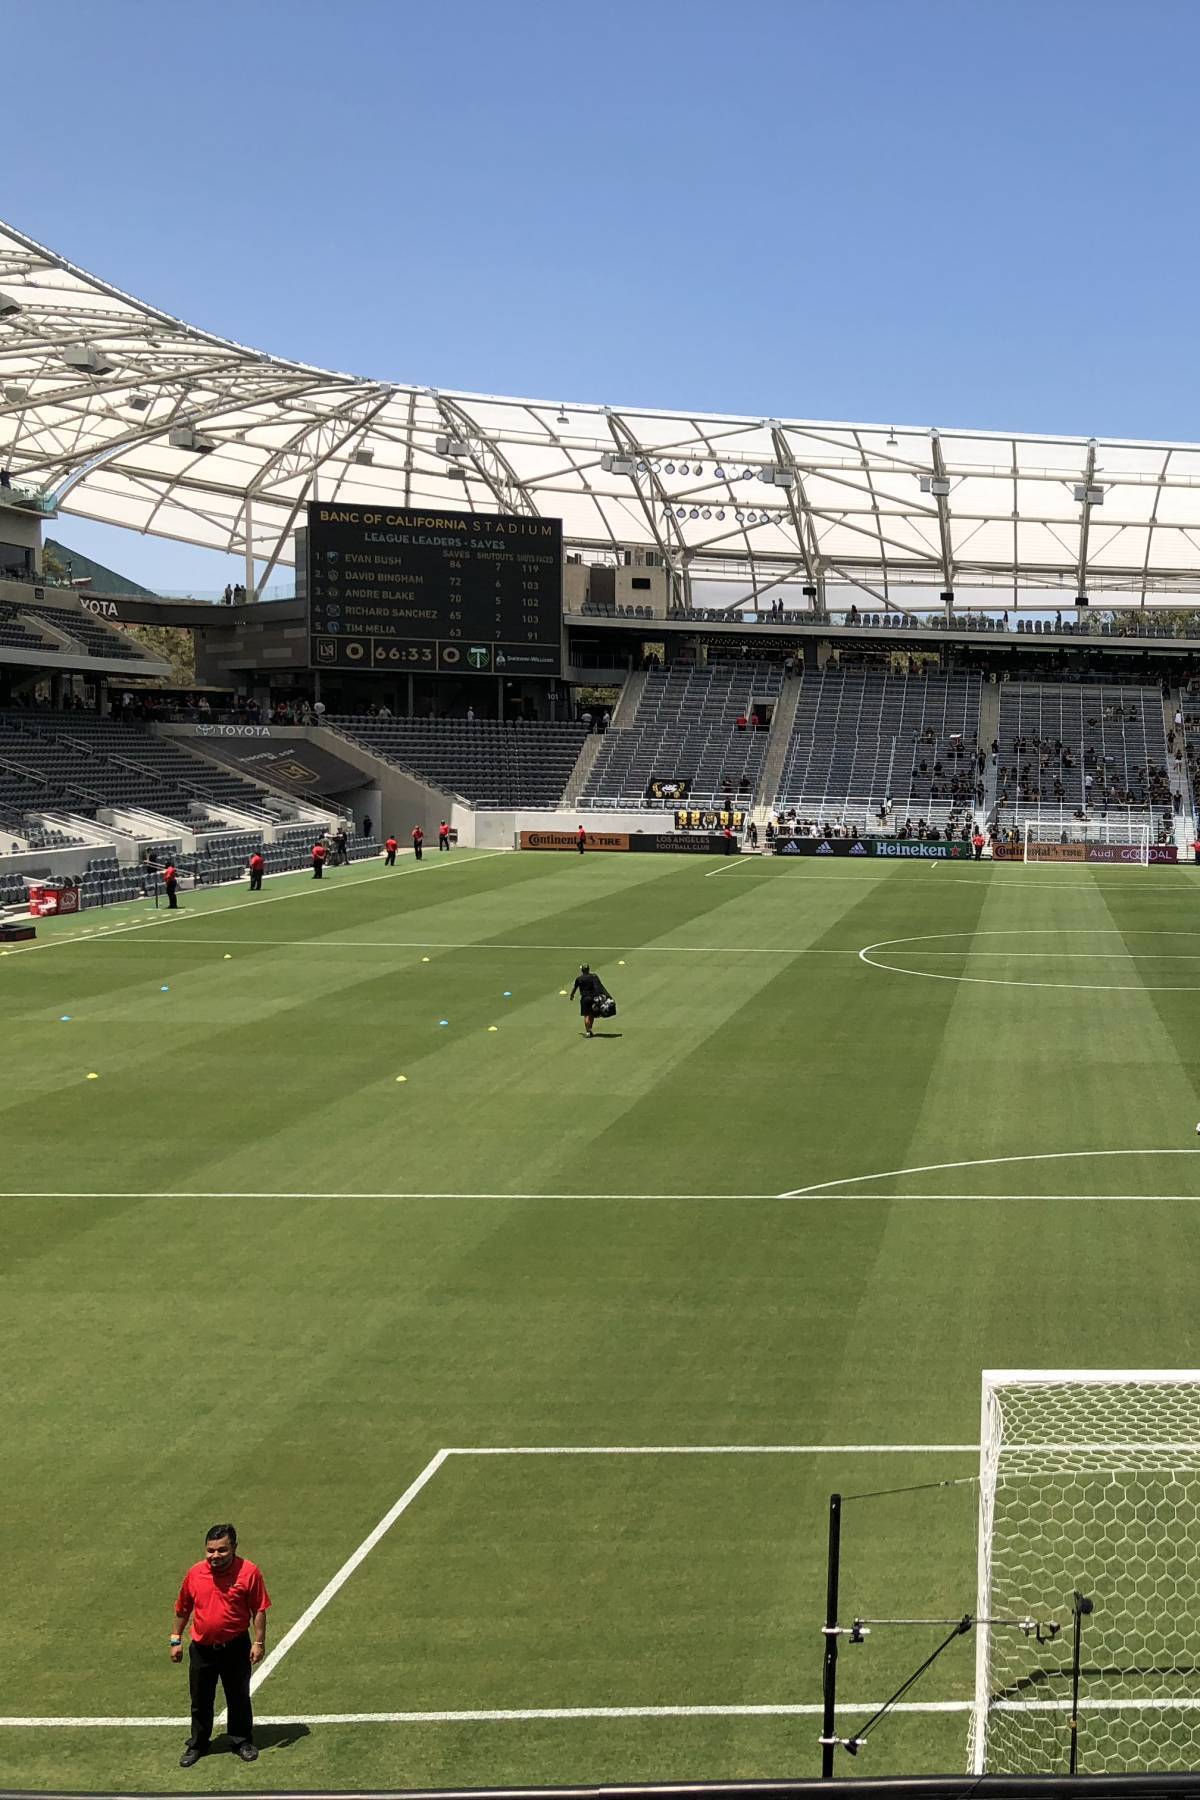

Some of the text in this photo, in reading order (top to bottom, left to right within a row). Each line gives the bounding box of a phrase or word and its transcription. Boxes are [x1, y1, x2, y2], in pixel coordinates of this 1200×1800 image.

[320, 510, 552, 536] BANC OF CALIFORNIA STADIUM
[364, 532, 409, 544] LEAGUE
[412, 535, 461, 547] LEADERS
[470, 539, 506, 550] SAVES
[345, 553, 372, 564] EVAN
[374, 555, 402, 566] BUSH
[345, 570, 375, 581] DAVID
[377, 572, 424, 584] BINGHAM
[345, 589, 380, 599] ANDRE
[382, 590, 415, 601] BLAKE
[345, 606, 389, 617] RICHARD
[391, 608, 438, 619] SANCHEZ
[345, 623, 363, 633] TIM
[365, 624, 396, 634] MELIA
[375, 646, 432, 661] 66:33
[218, 726, 270, 737] TOYOTA
[529, 833, 621, 847] Continent TIRE
[656, 836, 710, 844] LOS ANGELES
[876, 842, 947, 857] Heineken
